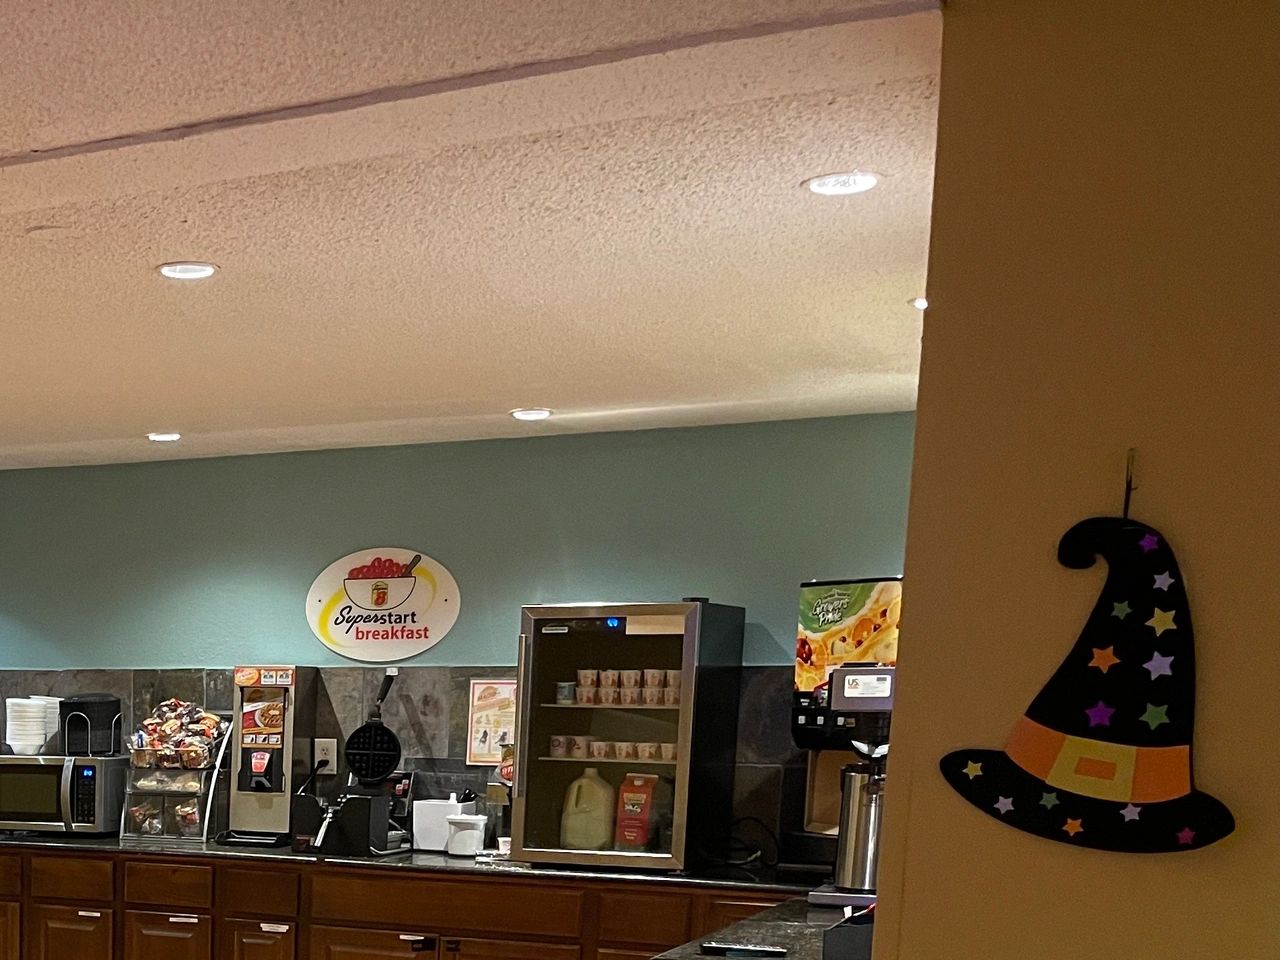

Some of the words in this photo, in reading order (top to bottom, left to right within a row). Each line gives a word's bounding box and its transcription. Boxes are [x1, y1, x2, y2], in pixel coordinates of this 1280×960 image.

[812, 598, 850, 615] Growers
[334, 605, 417, 635] Superstart
[355, 625, 430, 641] breakfast
